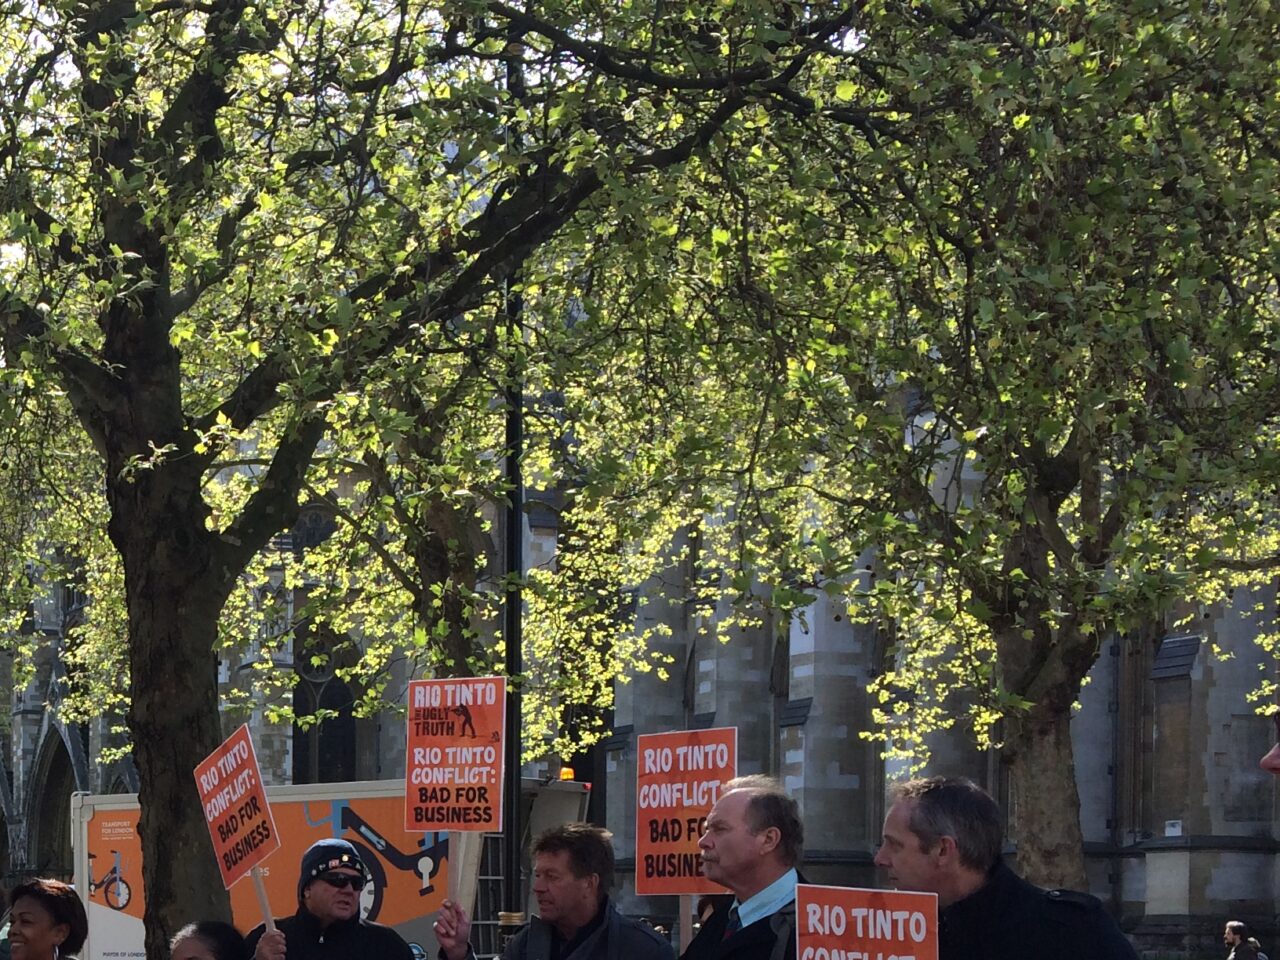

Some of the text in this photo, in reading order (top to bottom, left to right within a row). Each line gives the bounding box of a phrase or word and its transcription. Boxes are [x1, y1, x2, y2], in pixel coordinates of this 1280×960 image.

[415, 683, 496, 708] RIO TINTO
[423, 707, 450, 720] UGLY
[415, 721, 455, 737] TRUTH
[200, 739, 249, 795] RIO TINTO
[413, 746, 496, 765] RIO TINTO
[644, 743, 728, 774] RIO TINTO
[411, 767, 496, 785] CONFLICT:
[206, 768, 256, 823] CONFLICT:
[418, 786, 489, 803] BAD FOR
[639, 780, 721, 809] CONFLICT
[217, 796, 262, 844] BAD FOR
[414, 806, 492, 823] BUSINESS
[649, 817, 708, 843] BAD FO
[222, 819, 271, 872] BUSINESS
[644, 854, 705, 878] BUSINE
[806, 903, 927, 943] RIO TINTO
